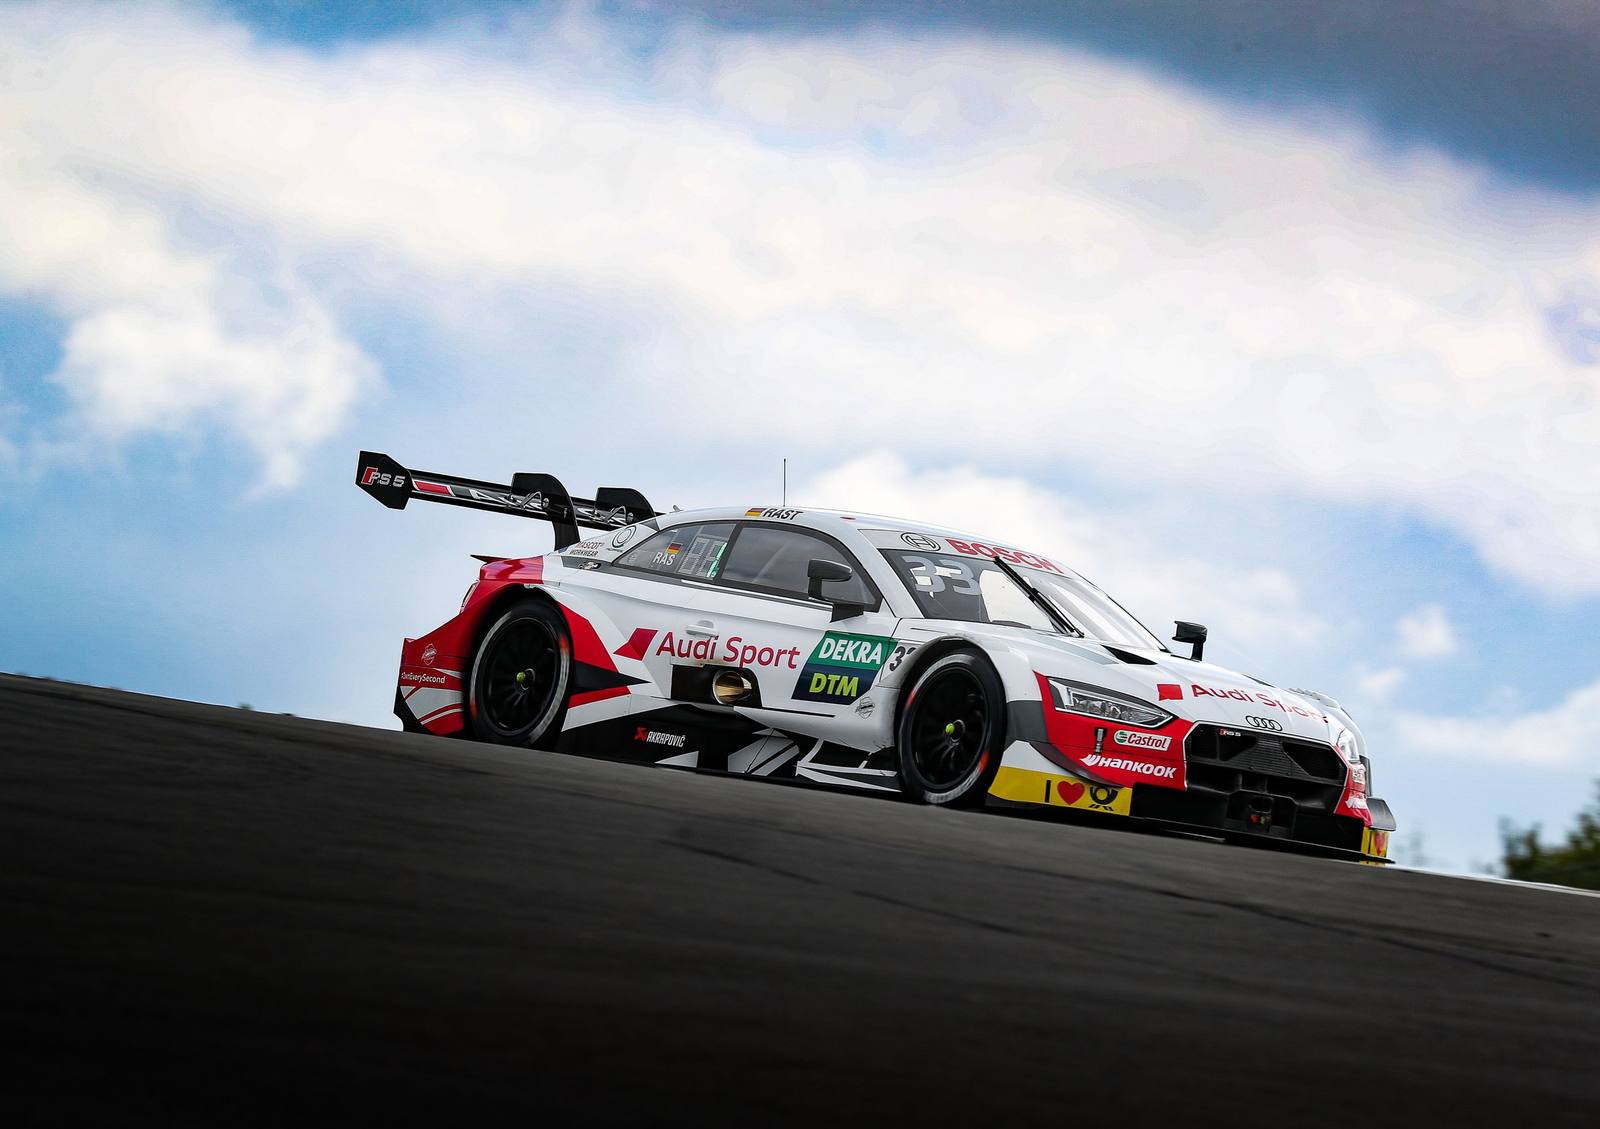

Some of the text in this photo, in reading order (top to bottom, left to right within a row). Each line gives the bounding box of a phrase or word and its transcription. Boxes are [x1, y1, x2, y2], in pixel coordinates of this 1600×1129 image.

[392, 475, 406, 488] 5
[763, 508, 804, 521] RAST
[945, 538, 1064, 574] BOSCH
[902, 555, 981, 596] 33
[656, 631, 801, 669] Audi Sport
[817, 637, 882, 665] DEKRA
[889, 646, 917, 672] 3
[808, 672, 860, 698] DTM
[1190, 684, 1329, 724] Audi Spor
[1127, 733, 1167, 749] Castrol
